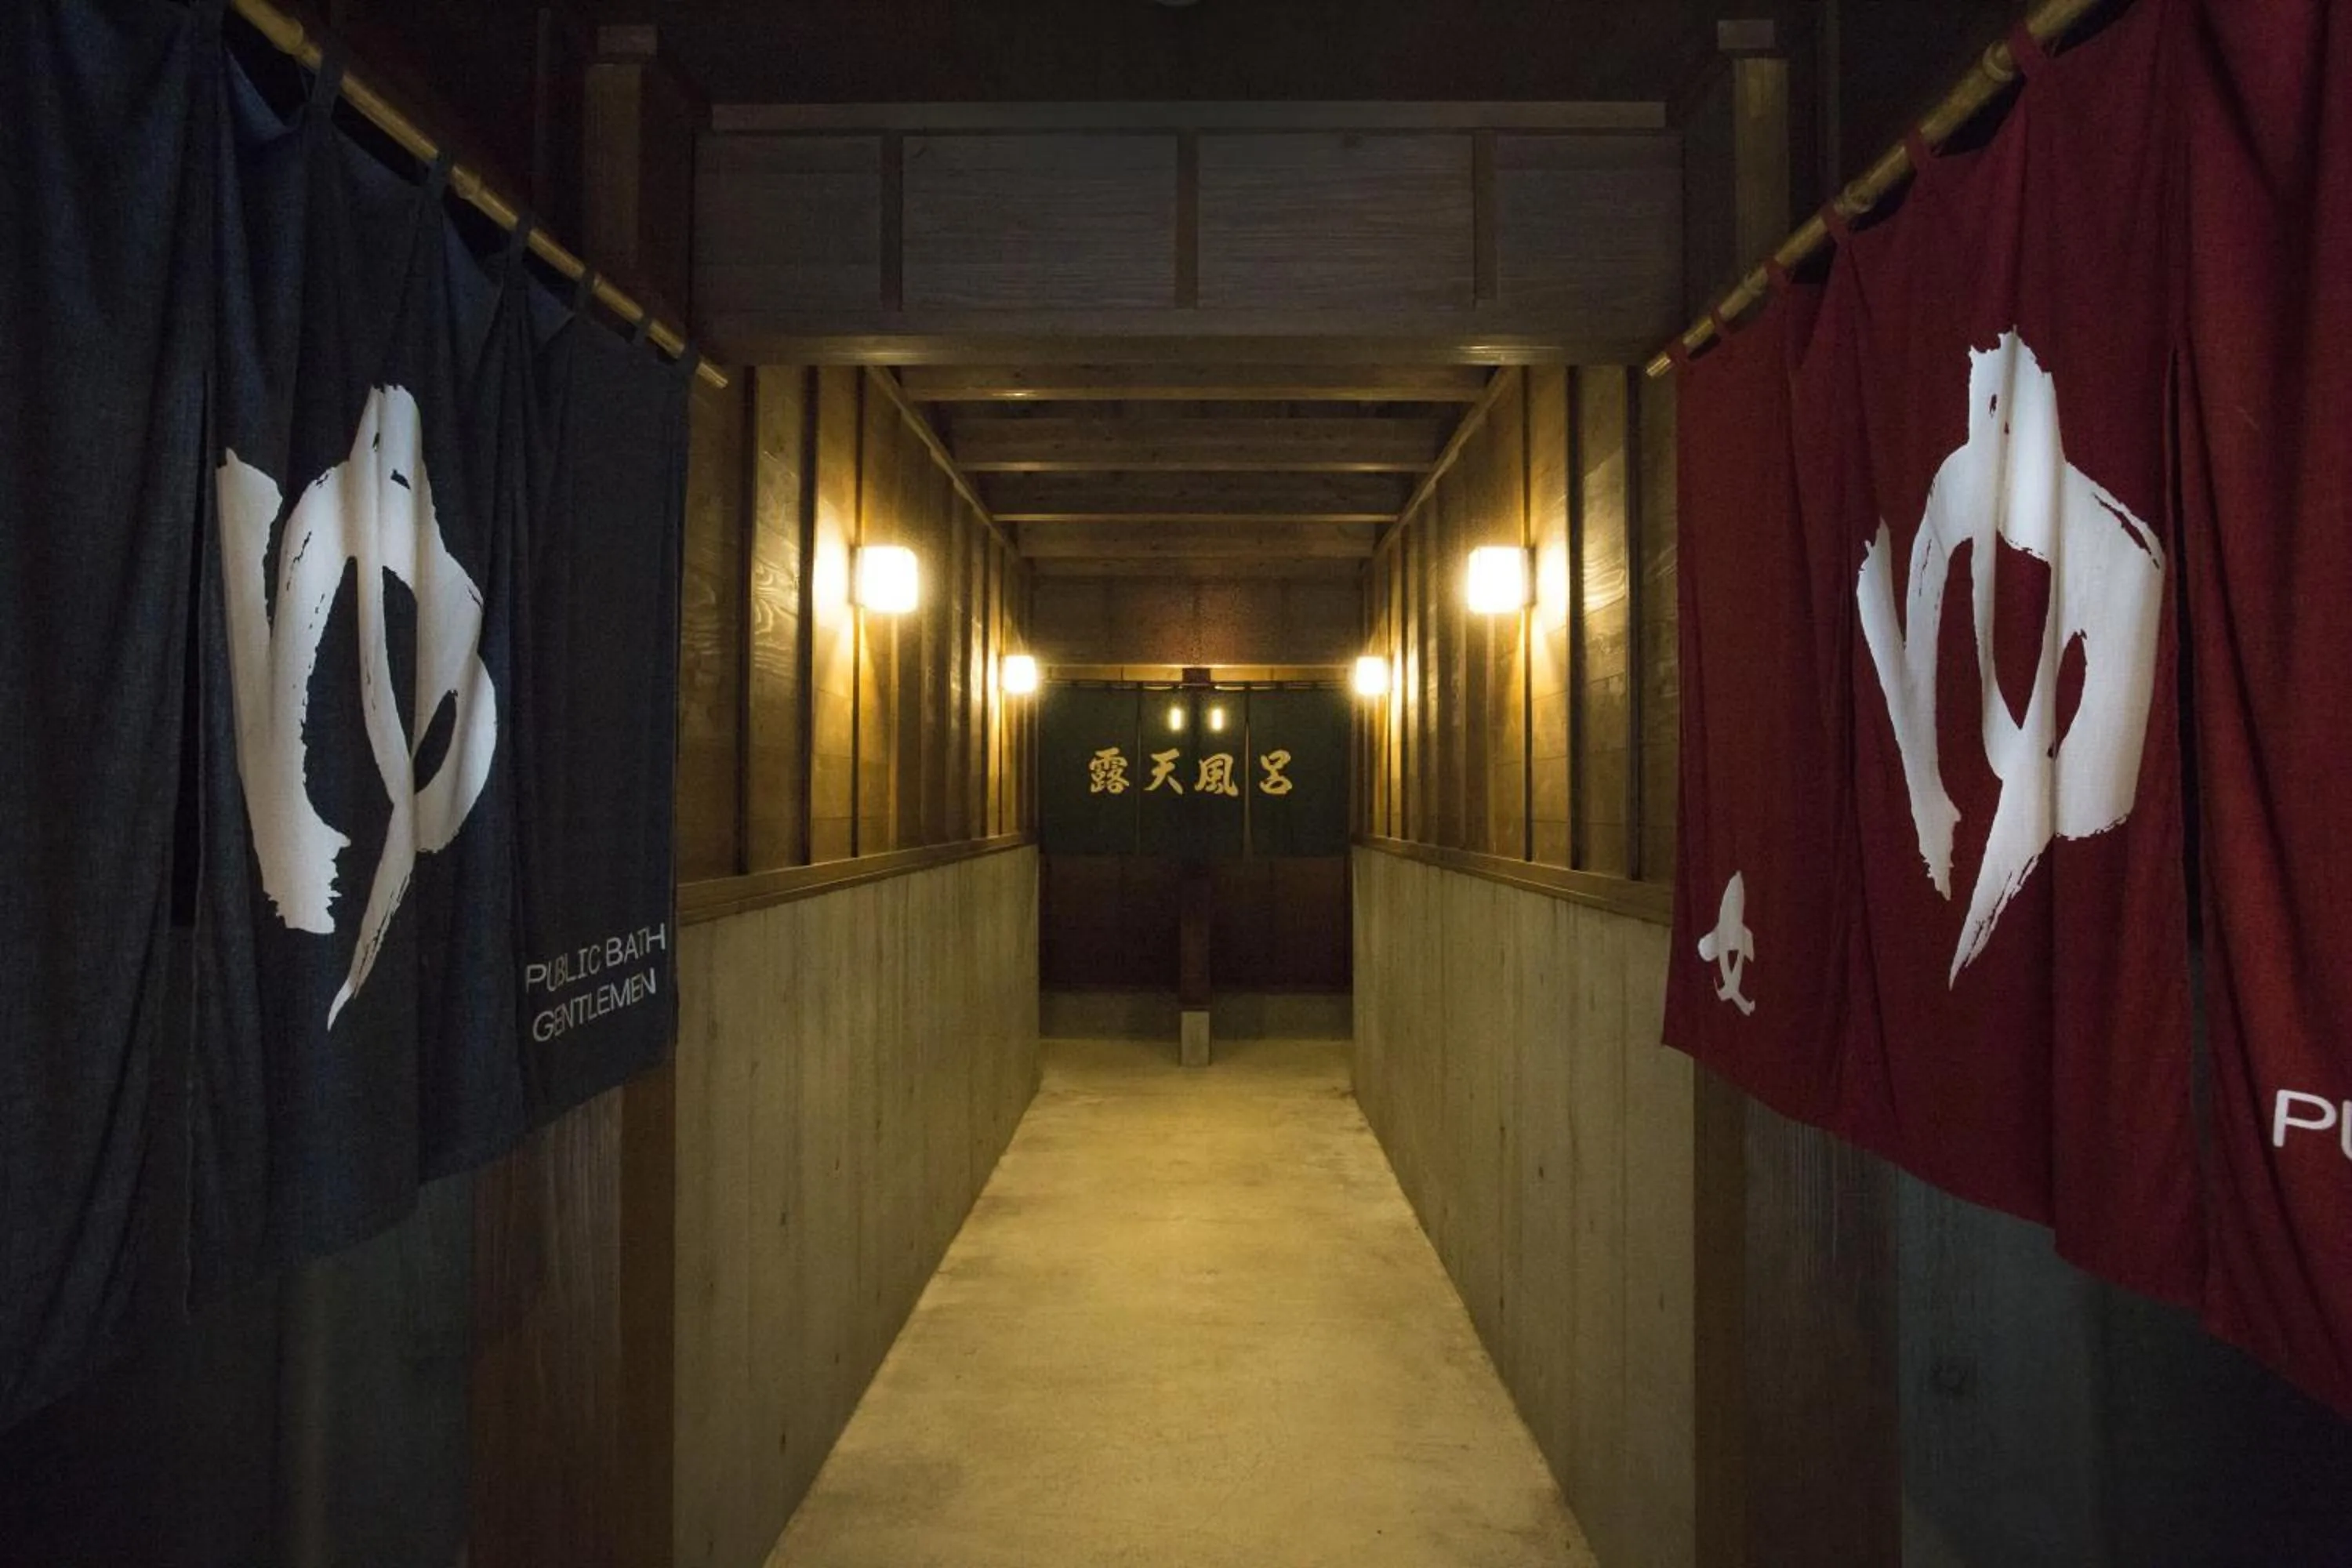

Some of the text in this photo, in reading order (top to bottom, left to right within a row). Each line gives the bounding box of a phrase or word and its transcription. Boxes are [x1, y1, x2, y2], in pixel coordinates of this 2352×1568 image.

[1857, 325, 2165, 990] ゆ
[216, 385, 497, 1031] ゆ
[1088, 747, 1293, 797] 露天風呂
[525, 923, 666, 993] PUBLIC BATH
[532, 967, 656, 1042] GENTLEMEN
[2273, 1089, 2352, 1160] P
